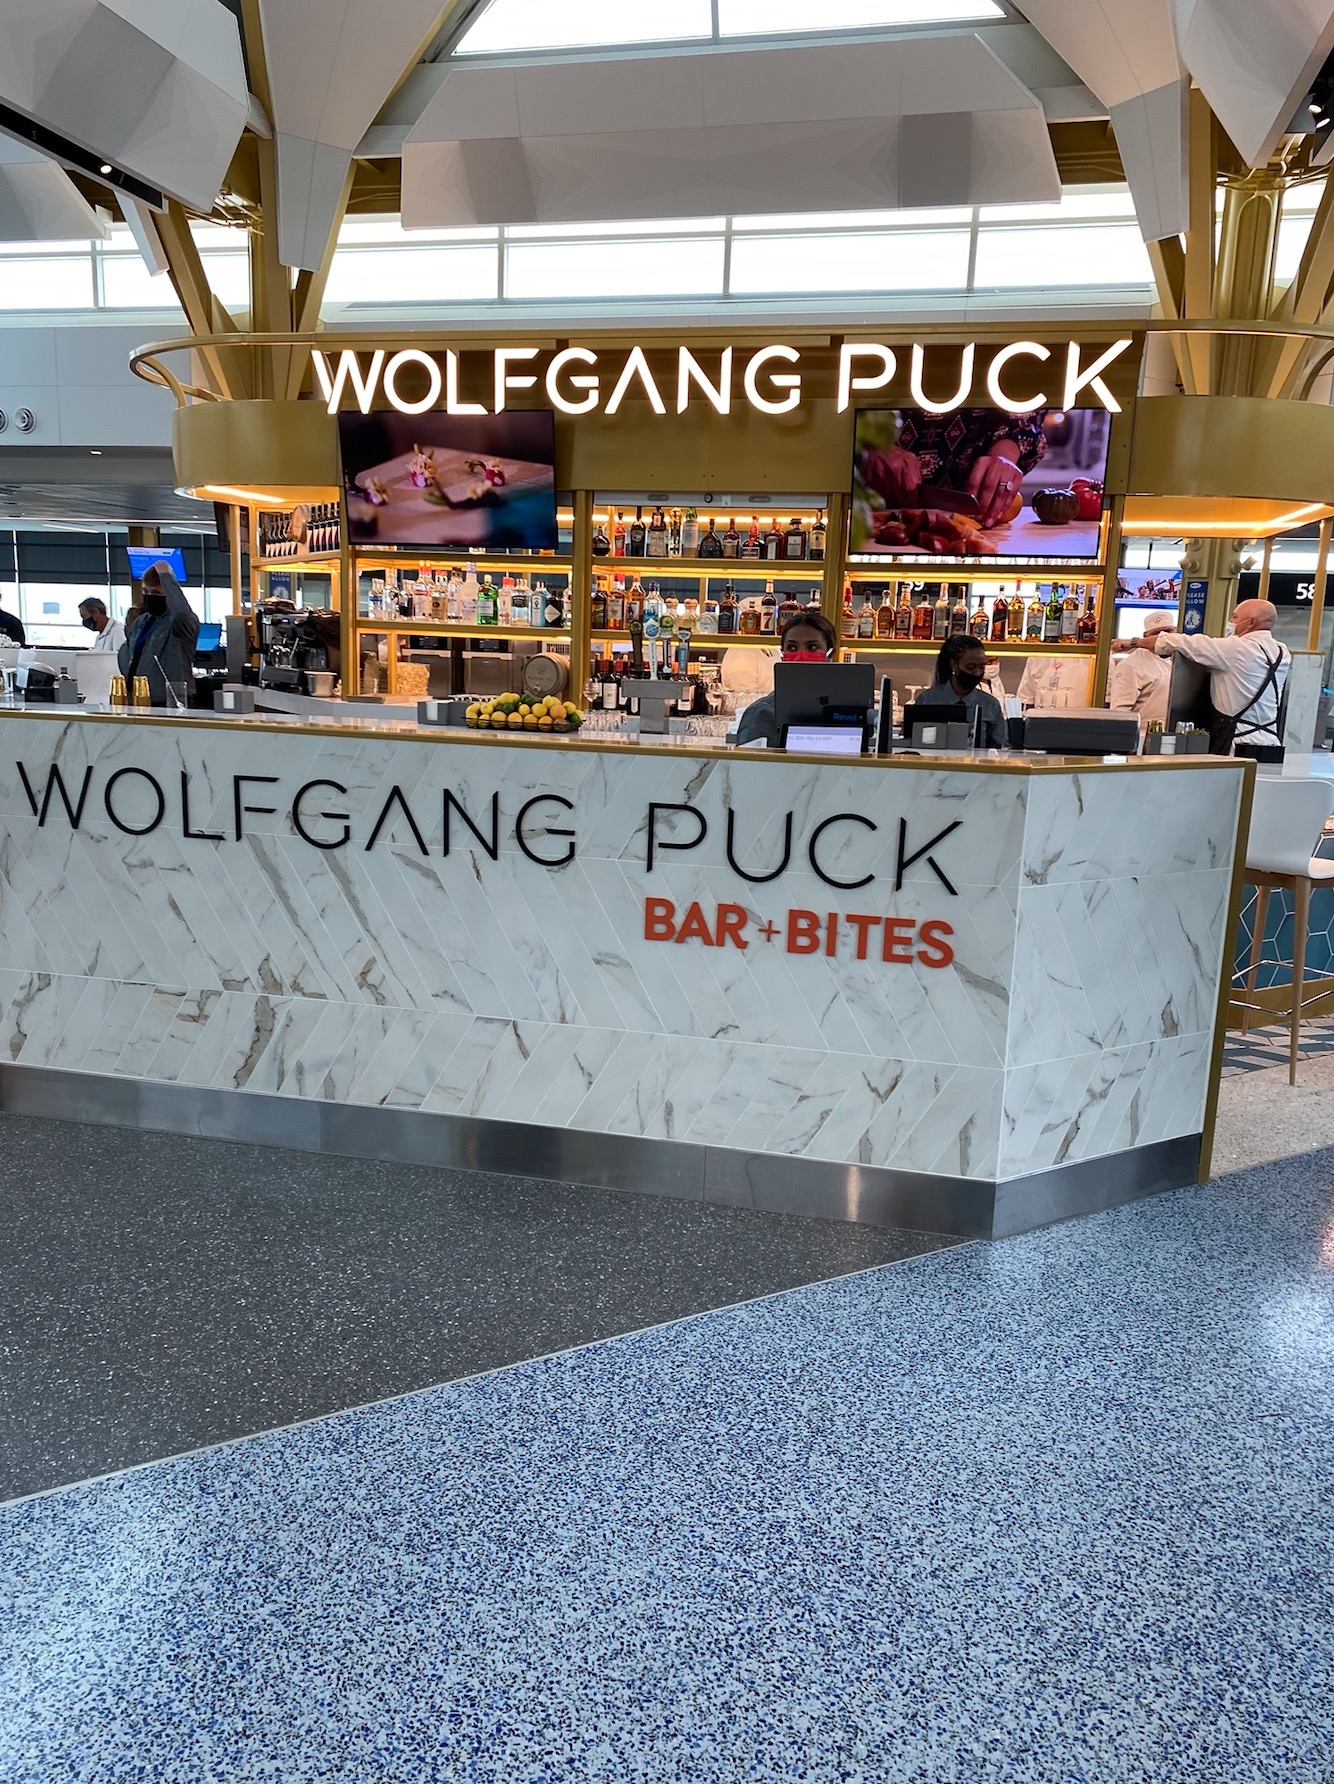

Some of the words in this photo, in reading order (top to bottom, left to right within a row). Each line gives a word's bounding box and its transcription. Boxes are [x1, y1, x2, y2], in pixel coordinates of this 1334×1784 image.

[311, 345, 801, 416] WOLFGANG
[837, 339, 1134, 415] PUCK
[833, 712, 857, 722] Revel
[16, 760, 576, 866] WOLFGANG
[646, 802, 963, 896] PUCK
